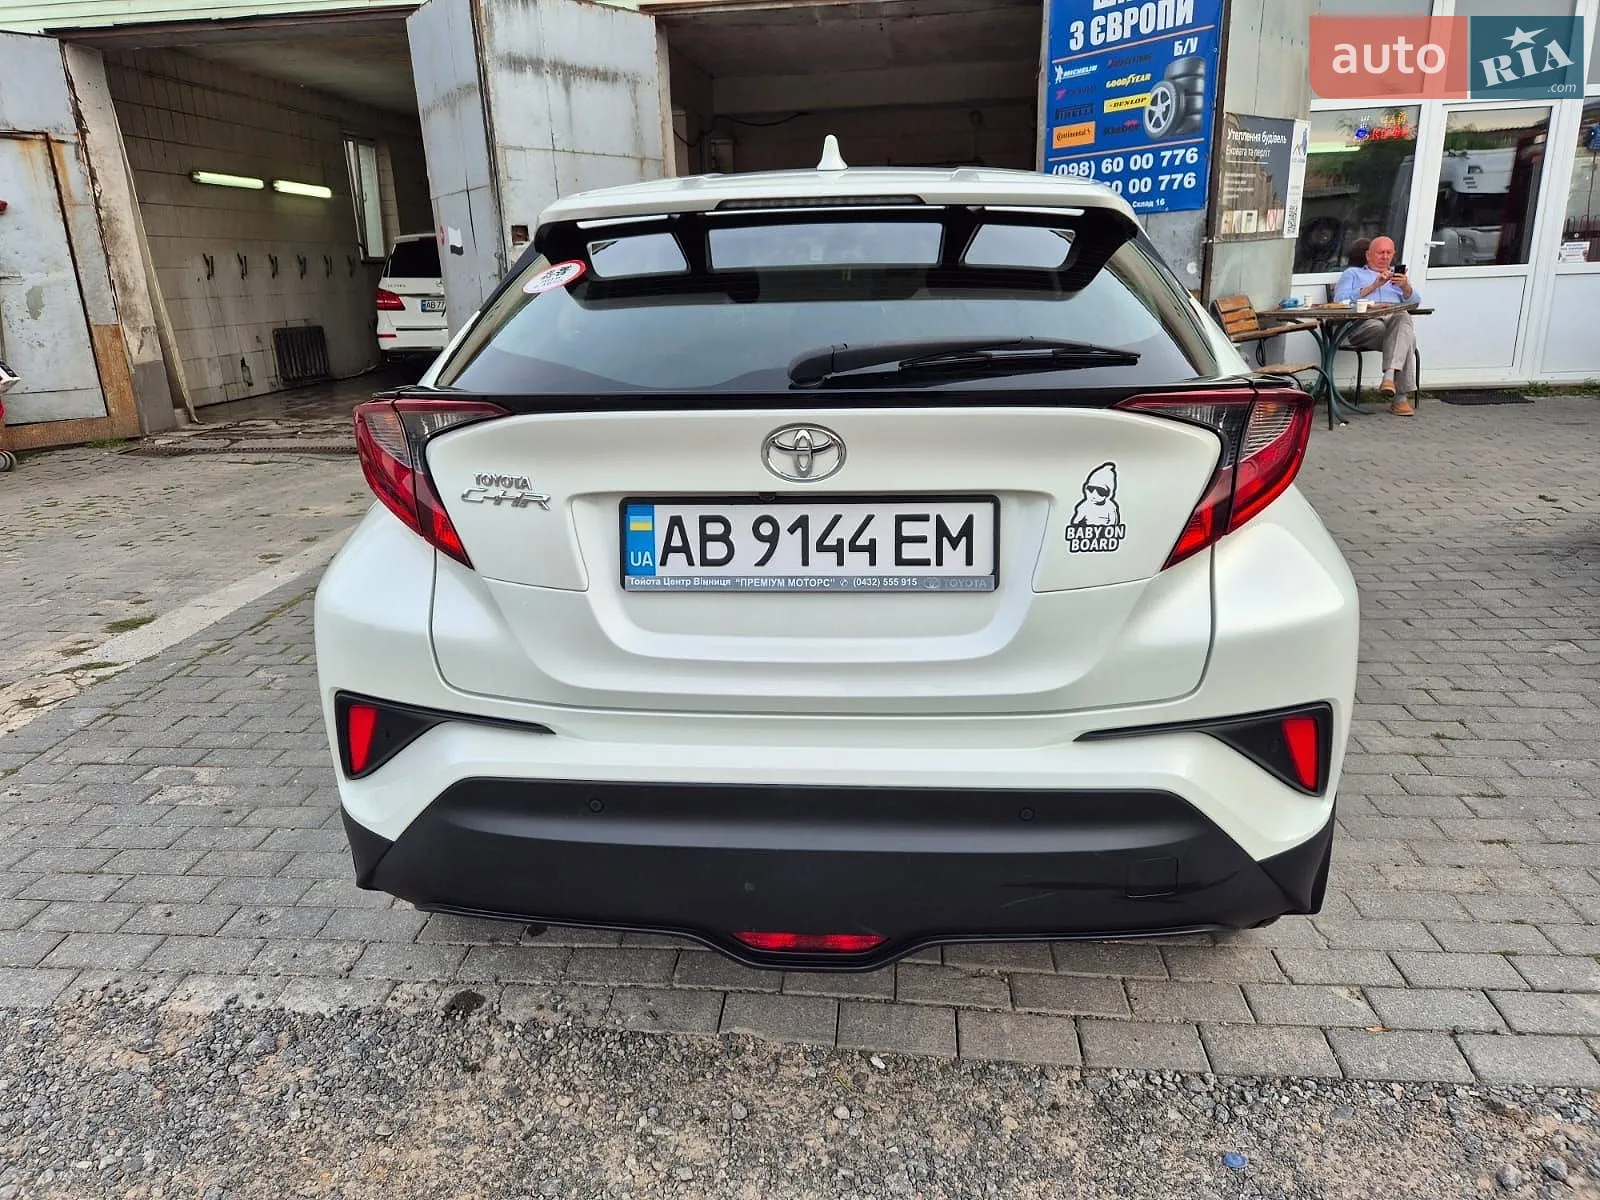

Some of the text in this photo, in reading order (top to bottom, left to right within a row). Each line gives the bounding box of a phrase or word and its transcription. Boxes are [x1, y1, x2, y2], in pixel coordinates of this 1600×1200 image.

[1090, 0, 1195, 46] ЄВРОПИ
[1173, 37, 1199, 57] Б/У
[1101, 157, 1125, 174] 60
[1129, 153, 1154, 171] 00
[1160, 147, 1199, 168] 776
[1128, 177, 1152, 194] 00
[1158, 172, 1197, 191] 776
[474, 472, 532, 490] TOYOTA
[659, 514, 974, 567] AB 9144 EM
[1066, 525, 1124, 539] BABY ON
[1072, 538, 1118, 551] BOARD
[630, 551, 653, 567] UA
[853, 578, 881, 587] (0432)
[883, 578, 899, 586] 555
[900, 578, 918, 587] 915
